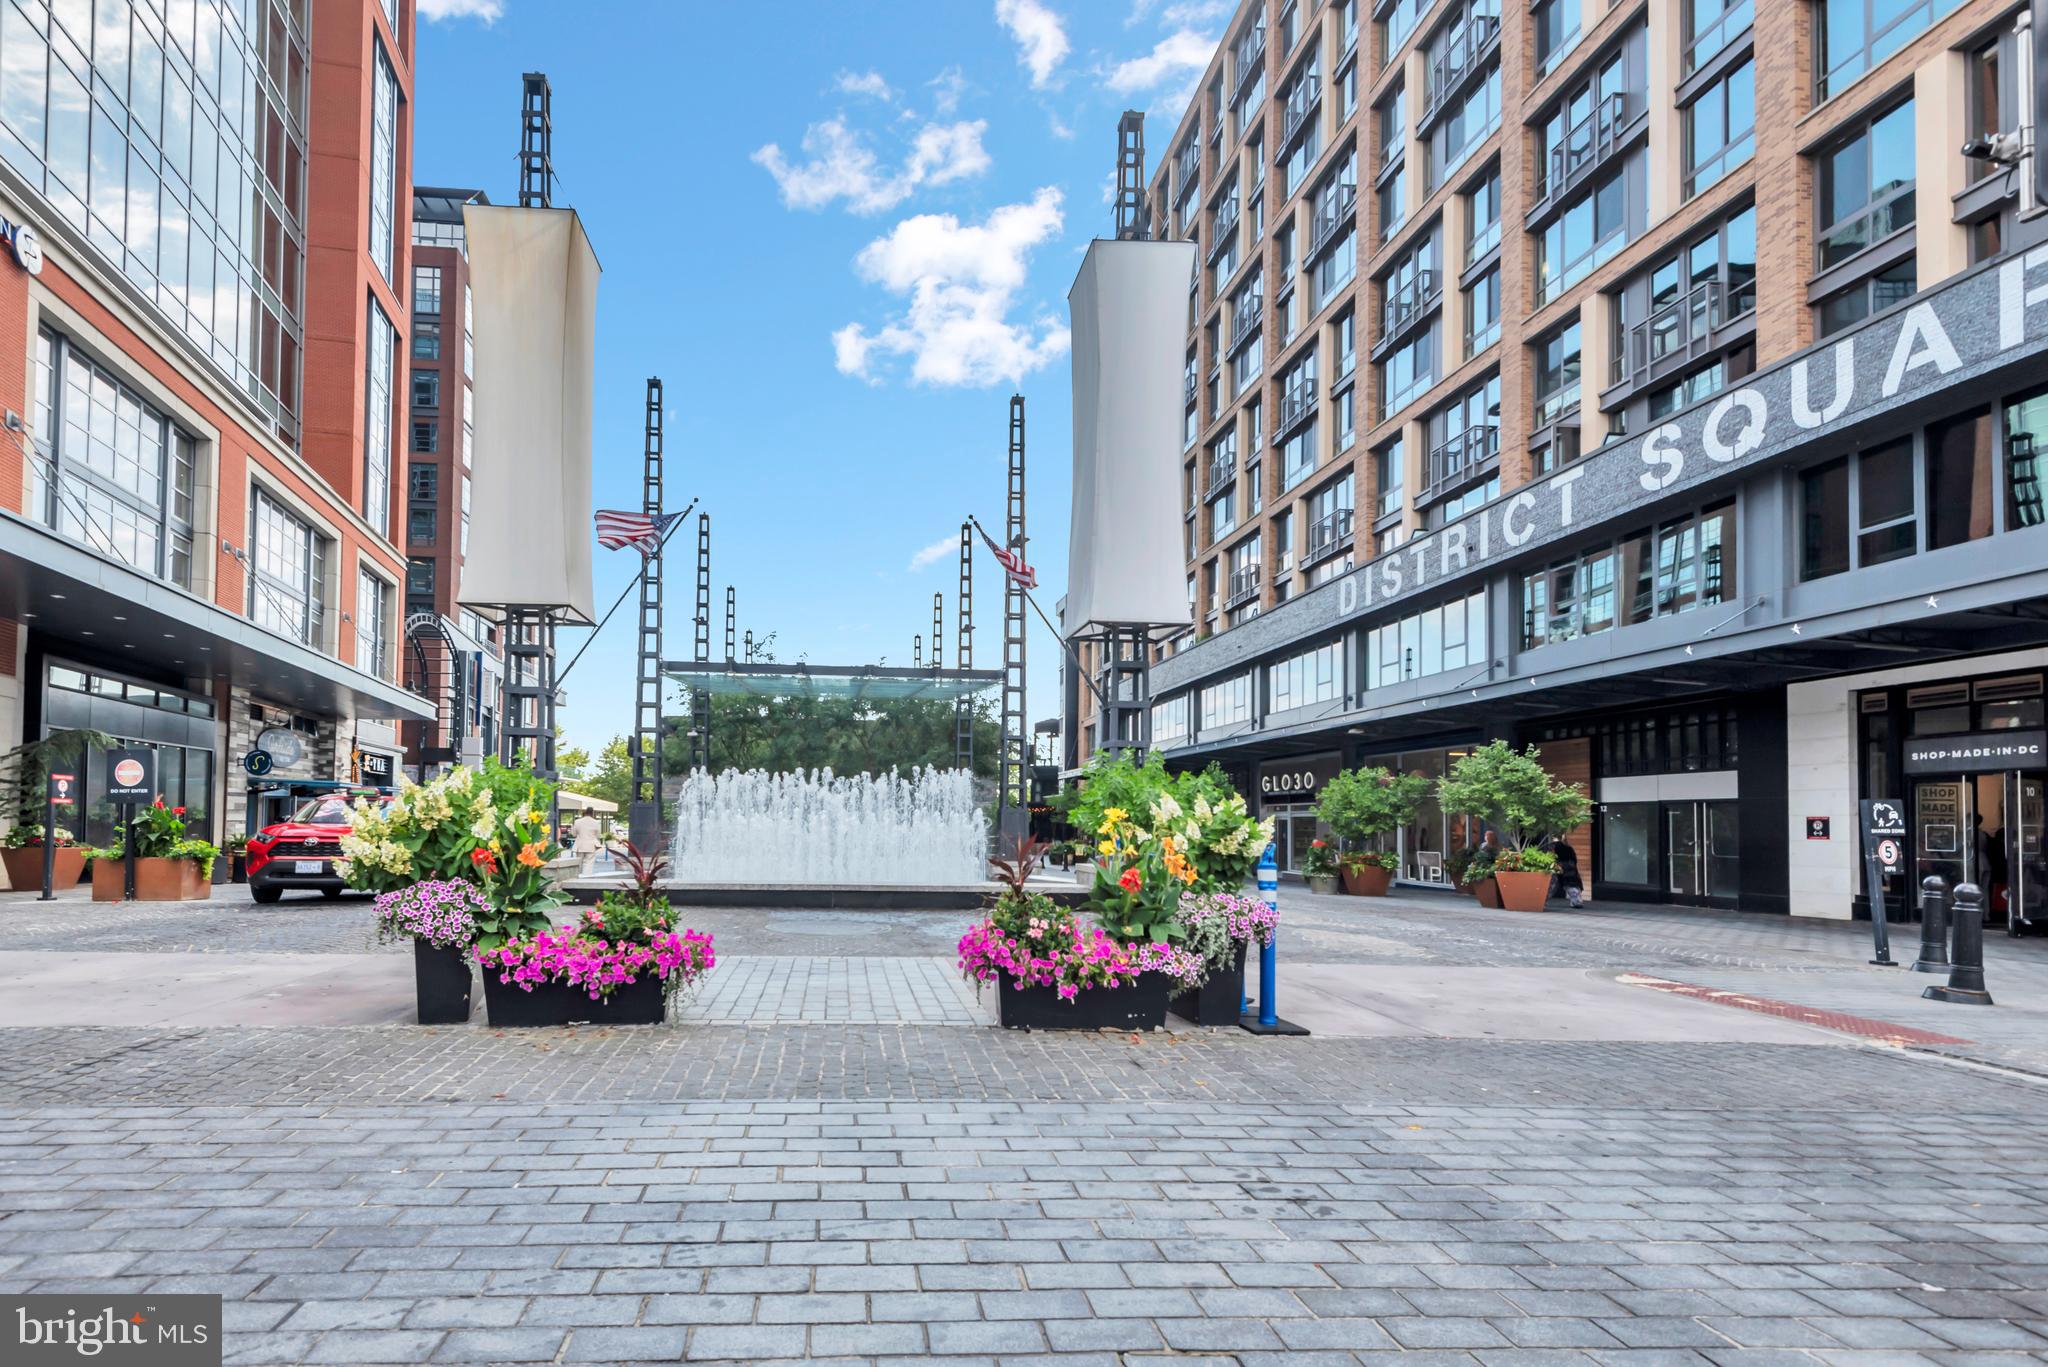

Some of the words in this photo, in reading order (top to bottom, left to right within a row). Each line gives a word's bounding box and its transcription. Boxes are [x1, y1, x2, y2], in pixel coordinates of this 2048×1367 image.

[1340, 465, 1584, 617] DISTRICT
[1261, 771, 1314, 792] GLO30
[1922, 788, 1955, 798] SHOP
[2026, 786, 2035, 797] 10
[1921, 803, 1955, 813] MADE
[1884, 845, 1893, 859] 5
